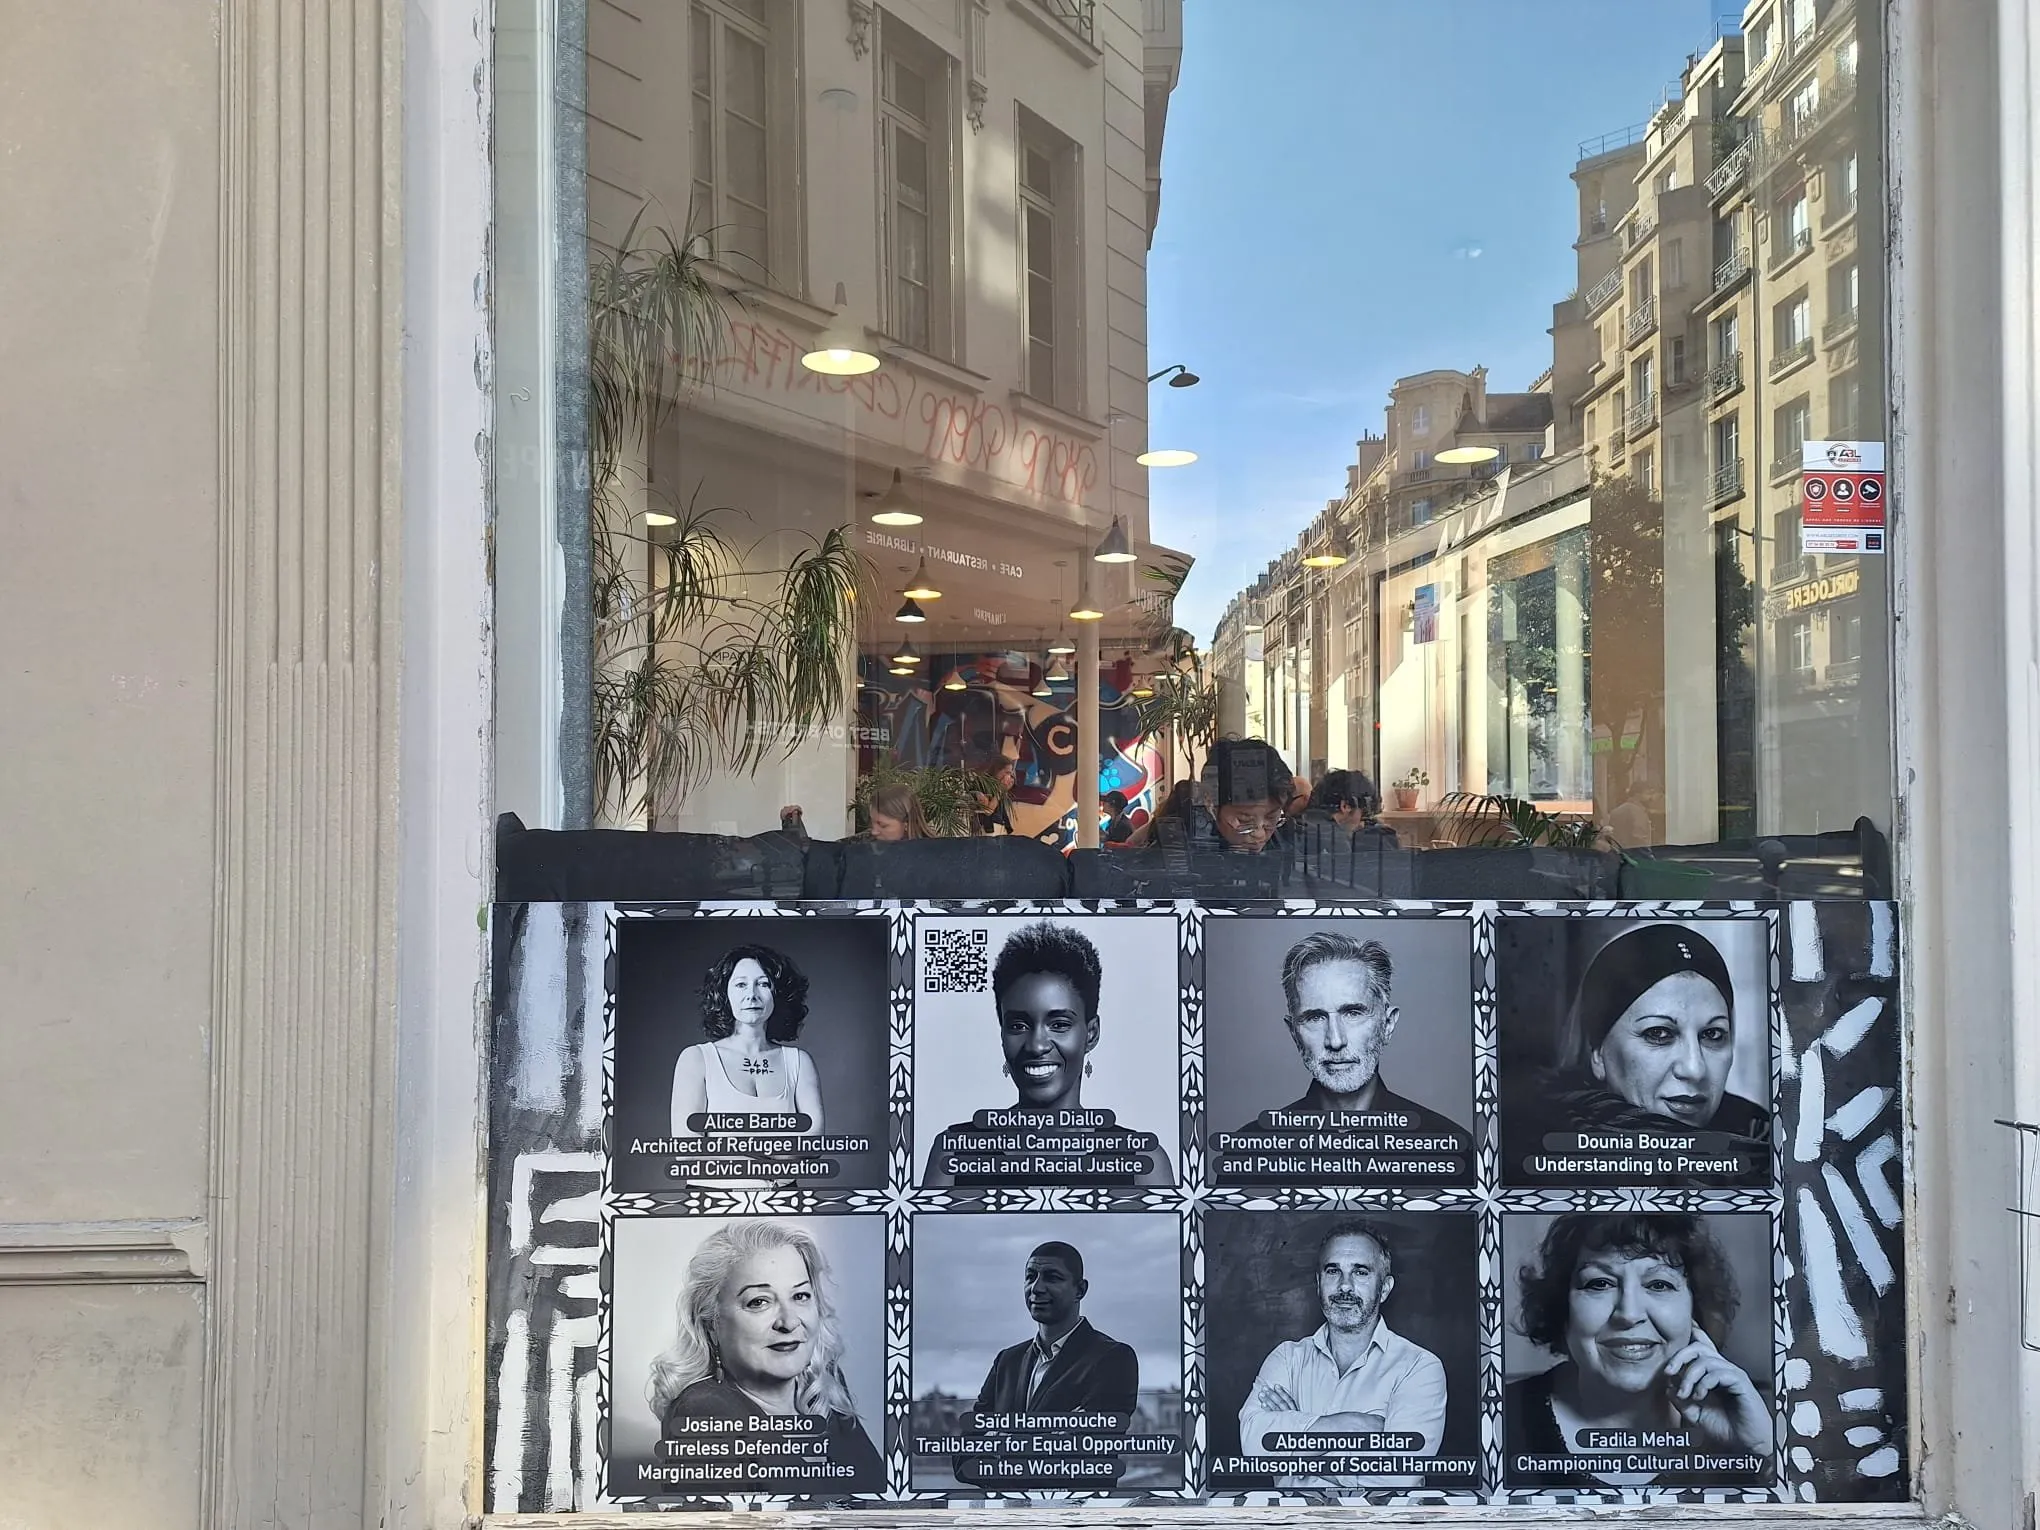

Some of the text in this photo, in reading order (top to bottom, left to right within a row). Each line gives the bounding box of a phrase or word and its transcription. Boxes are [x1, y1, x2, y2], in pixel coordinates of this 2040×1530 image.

[704, 1113, 797, 1131] Alice Barbe
[987, 1111, 1104, 1130] Rokhaya Diallo
[1268, 1111, 1408, 1130] Thierry Lhermitte
[630, 1135, 869, 1156] Architect of Refugee Inclusion
[943, 1134, 1149, 1154] Influential Campaigner for
[1219, 1134, 1459, 1150] Promoter of Medical Research
[1577, 1133, 1696, 1149] Dounia Bouzar
[669, 1159, 830, 1176] and Civic Innovation
[948, 1158, 1142, 1174] Social and Racial Justice
[1223, 1157, 1456, 1173] and Public Health Awareness
[1535, 1156, 1738, 1176] Understanding to Prevent
[680, 1416, 813, 1433] Josiane Balasko
[974, 1412, 1117, 1428] Saïd Hammouche
[664, 1439, 829, 1456] Tireless Defender of
[916, 1437, 1175, 1455] Trailblazer for Equal Opportunity
[1275, 1432, 1413, 1449] Abdennour Bidar
[1589, 1431, 1691, 1447] Fadila Mehal
[638, 1462, 855, 1484] Marginalized Communities
[979, 1460, 1113, 1478] in the Workplace
[1212, 1456, 1477, 1476] A Philosopher of Social Harmony
[1517, 1454, 1764, 1475] Championing Cultural Diversity
